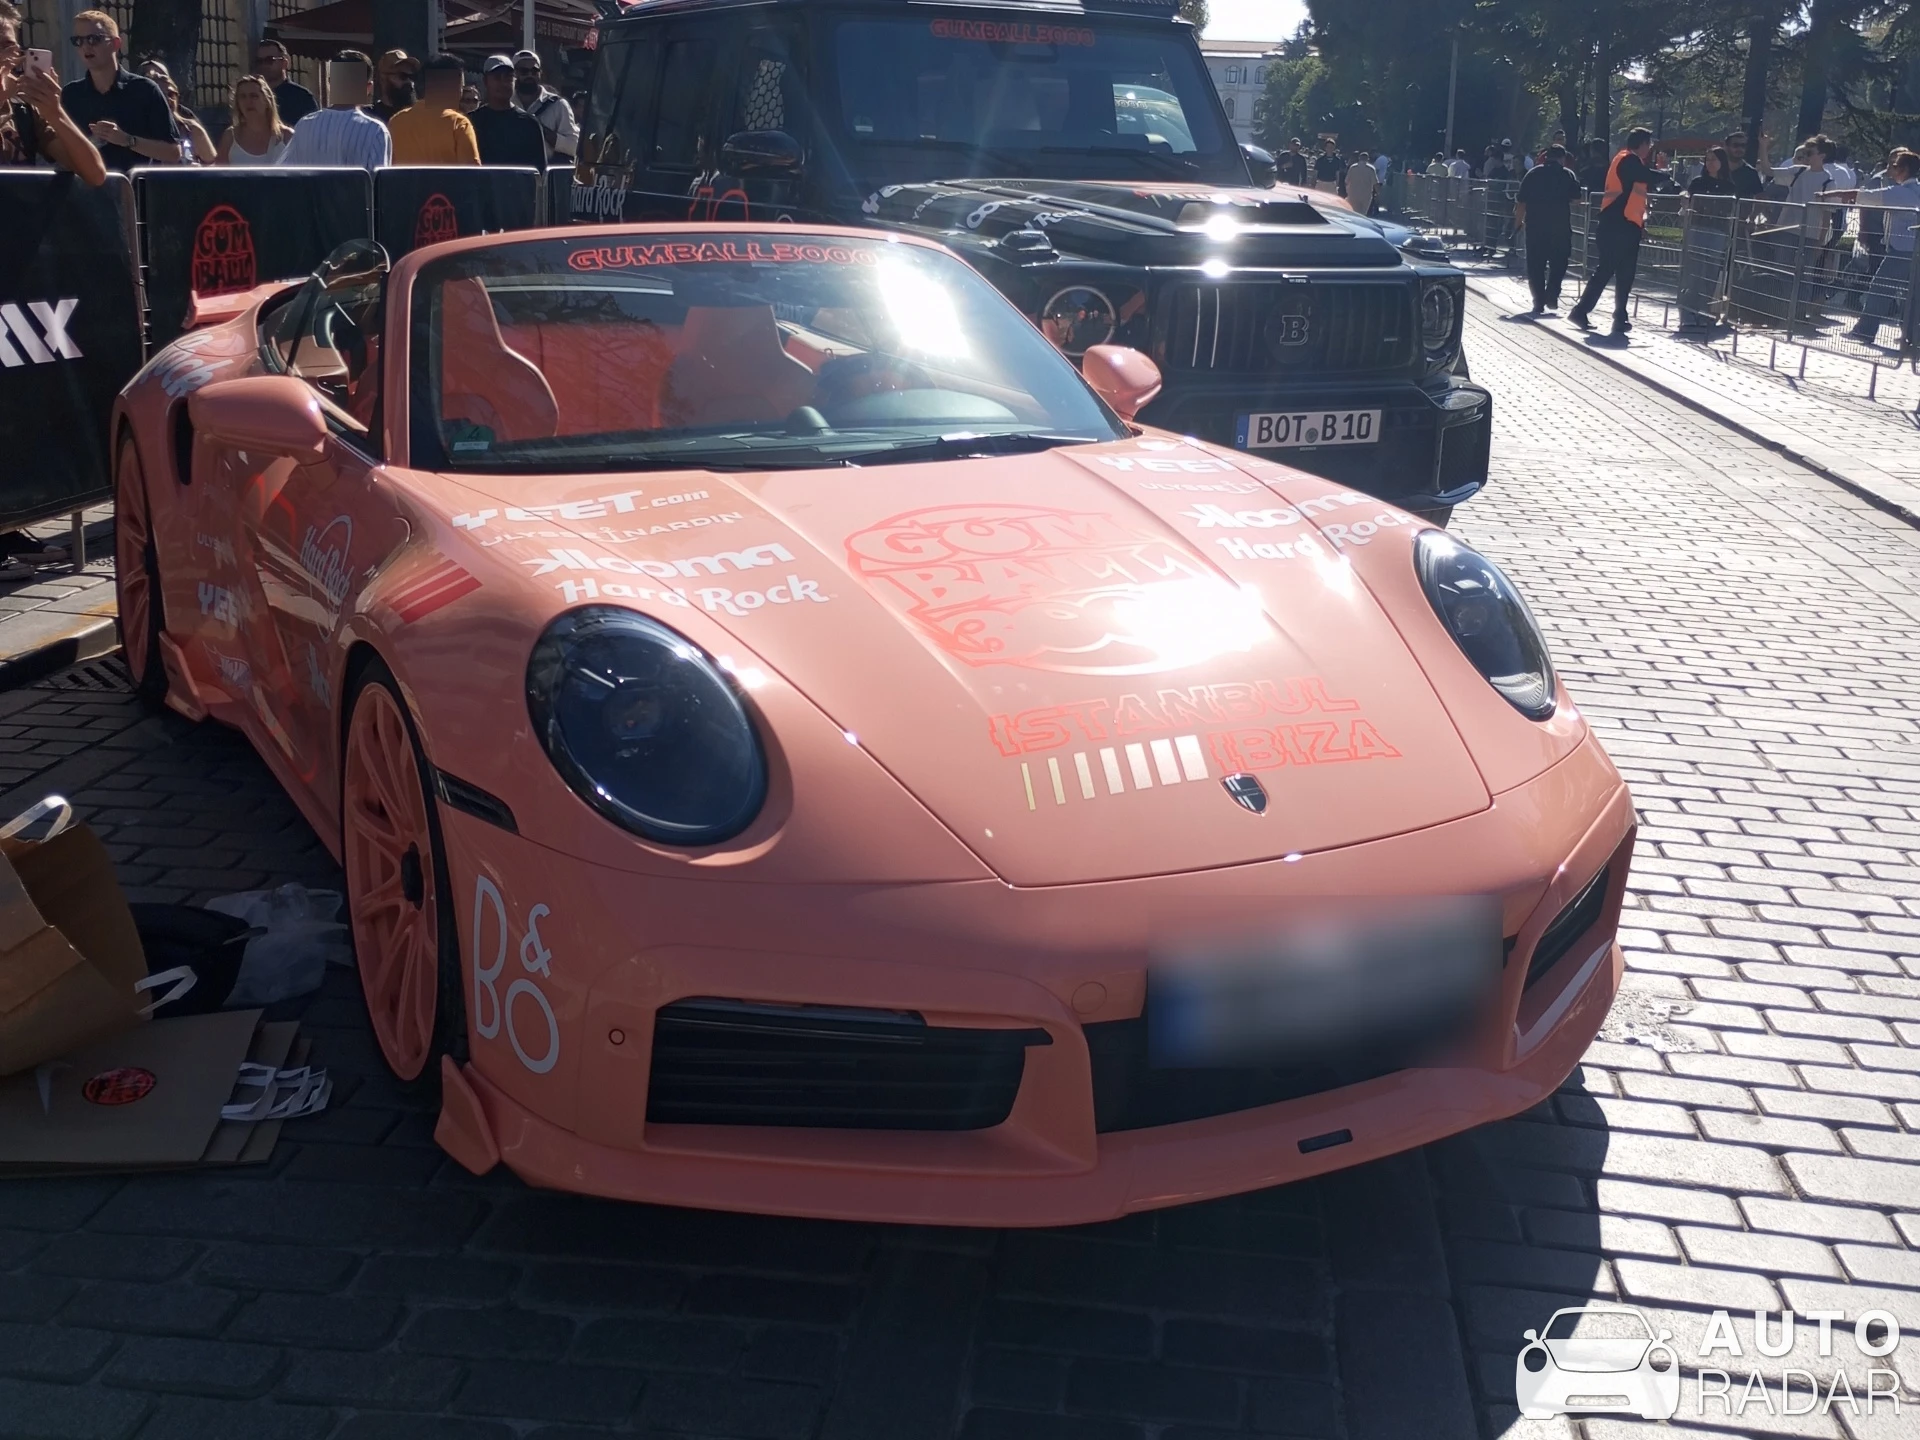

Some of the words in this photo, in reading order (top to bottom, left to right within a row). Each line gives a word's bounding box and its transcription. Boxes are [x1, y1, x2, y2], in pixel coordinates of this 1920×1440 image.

[930, 19, 1095, 47] GUMBALL3000
[595, 174, 627, 222] Rock
[567, 242, 878, 271] GUMBALL3000
[1256, 415, 1307, 444] BOT
[625, 511, 744, 538] NARDIN
[1216, 533, 1323, 561] Hard
[1321, 507, 1415, 549] Rock
[555, 577, 693, 608] Hard
[694, 573, 832, 618] Rock
[988, 675, 1361, 758] ISTANBUL
[1207, 718, 1403, 775] IBIZA
